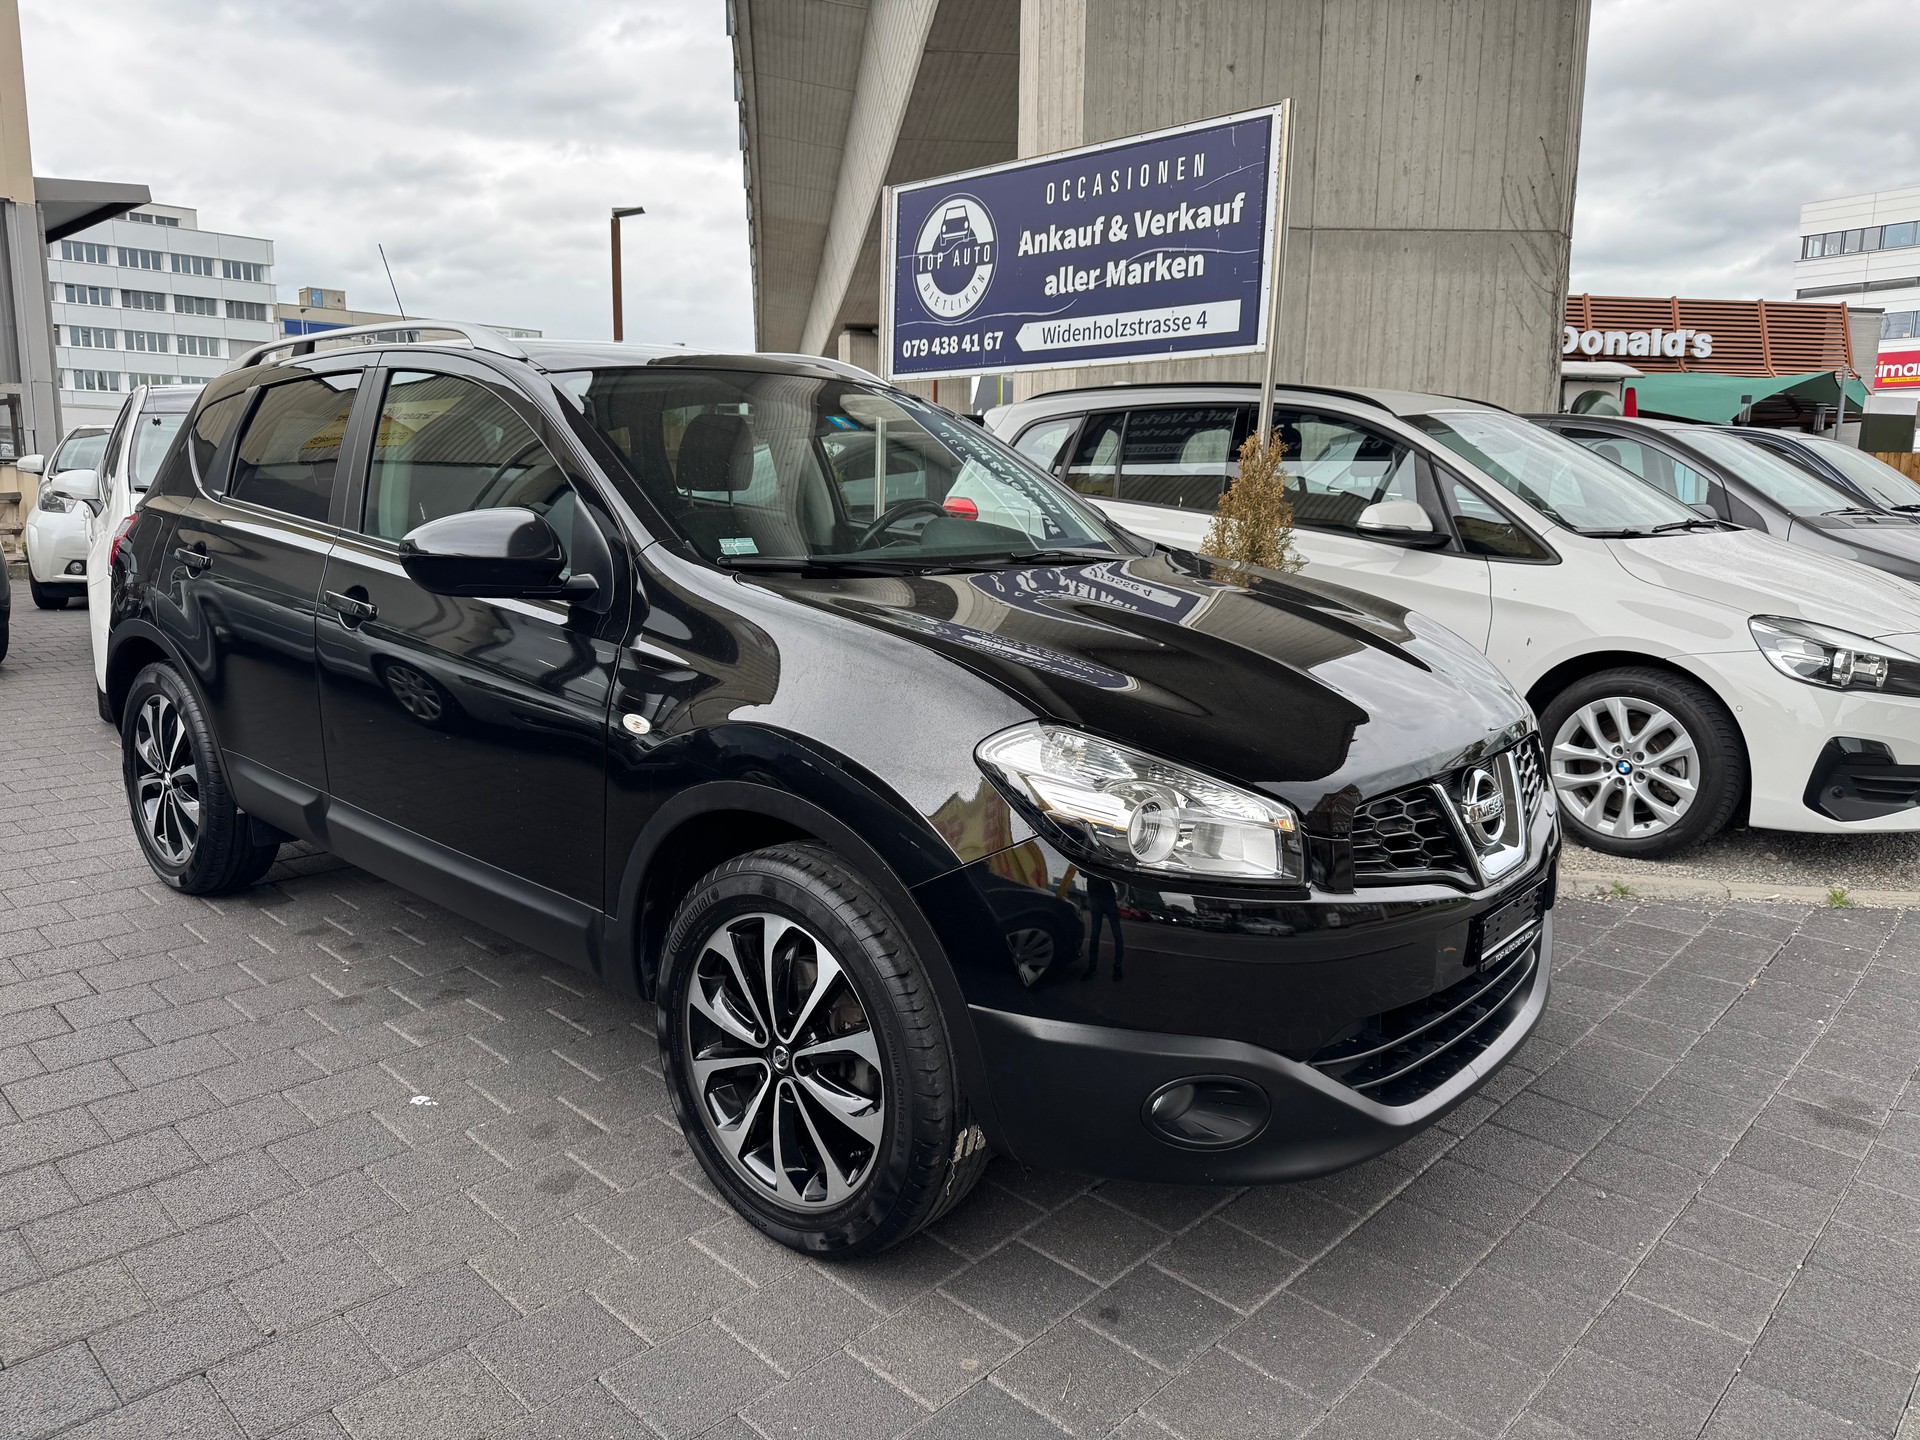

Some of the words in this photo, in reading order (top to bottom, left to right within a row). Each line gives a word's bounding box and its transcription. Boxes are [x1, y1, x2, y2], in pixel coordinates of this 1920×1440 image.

[1046, 153, 1205, 204] OCCASIONEN
[1018, 216, 1105, 257] Ankauf
[1108, 214, 1129, 242] &
[1134, 192, 1246, 239] Verkauf
[918, 251, 944, 272] TOP
[952, 244, 991, 268] AUTO
[1044, 265, 1102, 297] aller
[1105, 252, 1205, 288] Marken
[923, 274, 985, 311] DIETLIKON
[902, 339, 928, 358] 079
[931, 335, 958, 355] 438
[961, 332, 980, 353] 41
[983, 331, 1004, 352] 67
[1042, 312, 1192, 345] Widenholzstrasse
[1196, 310, 1208, 329] 4
